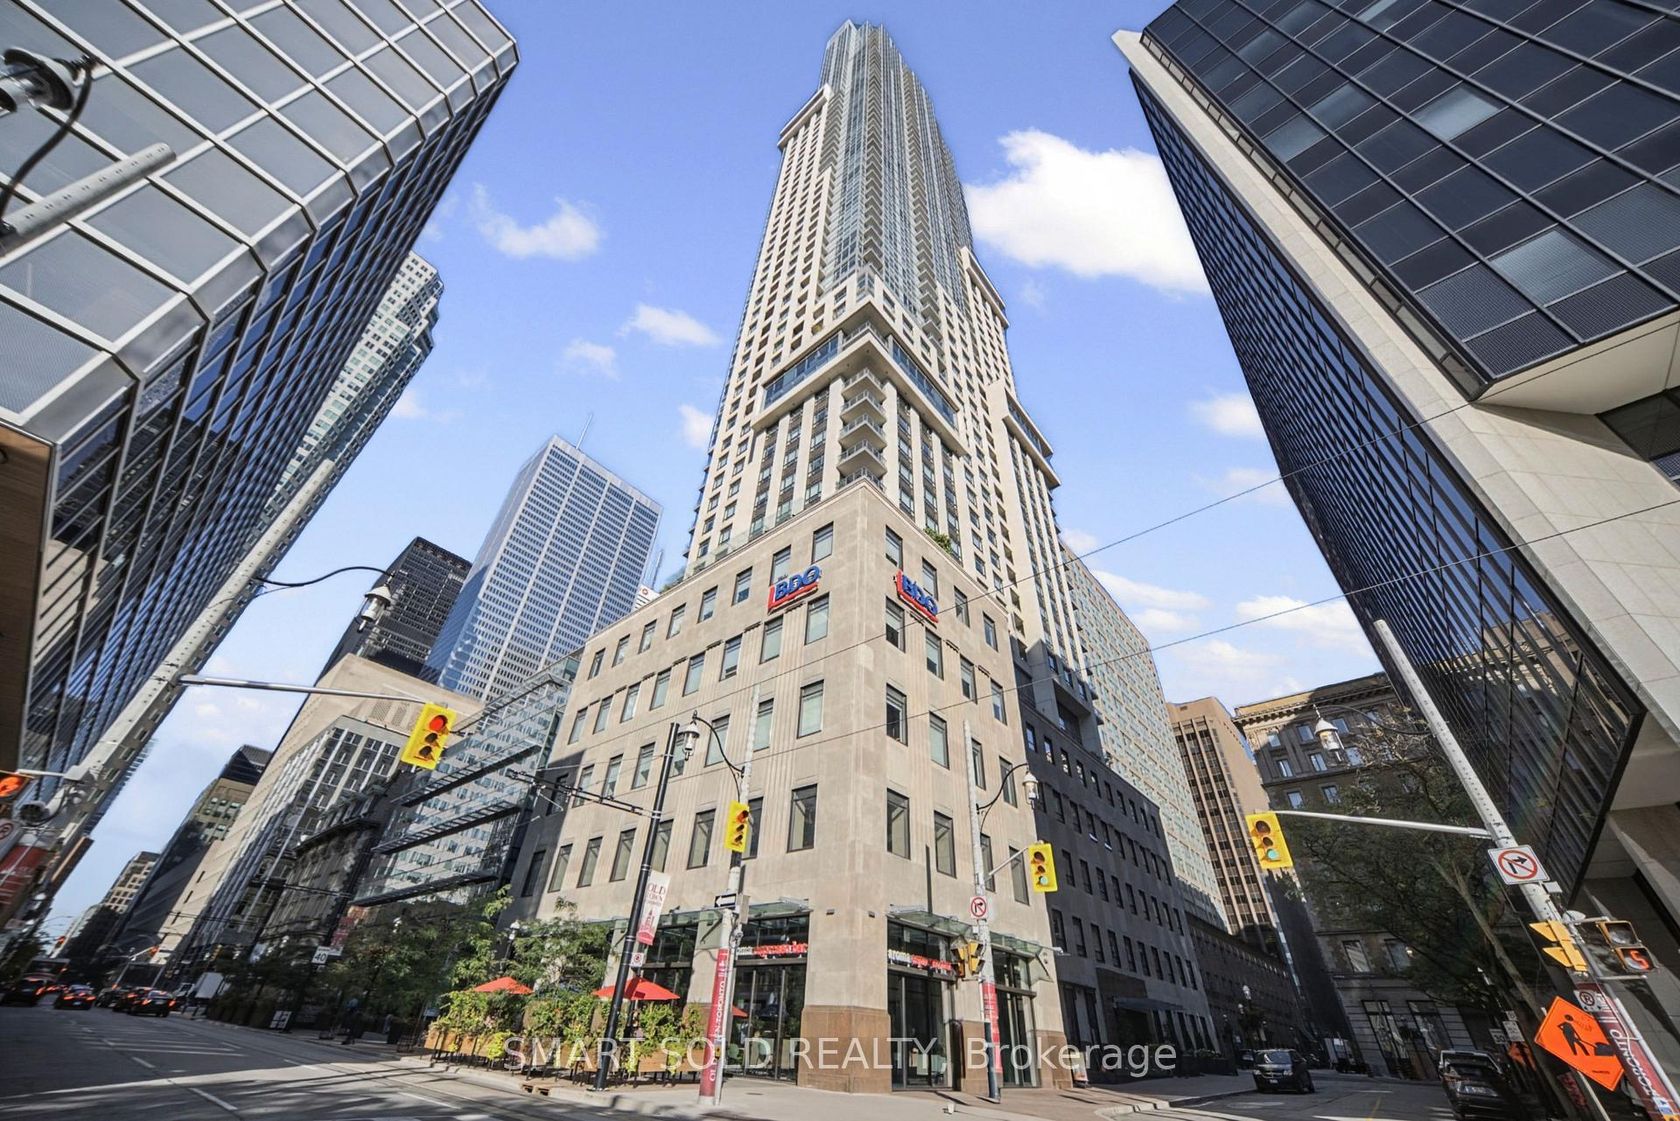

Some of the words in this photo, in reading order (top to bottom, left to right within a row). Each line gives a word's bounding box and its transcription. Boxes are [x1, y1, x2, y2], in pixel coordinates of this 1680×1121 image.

[775, 565, 820, 601] BDO
[902, 574, 938, 616] BDO
[647, 882, 666, 894] OLD
[314, 953, 327, 962] 40
